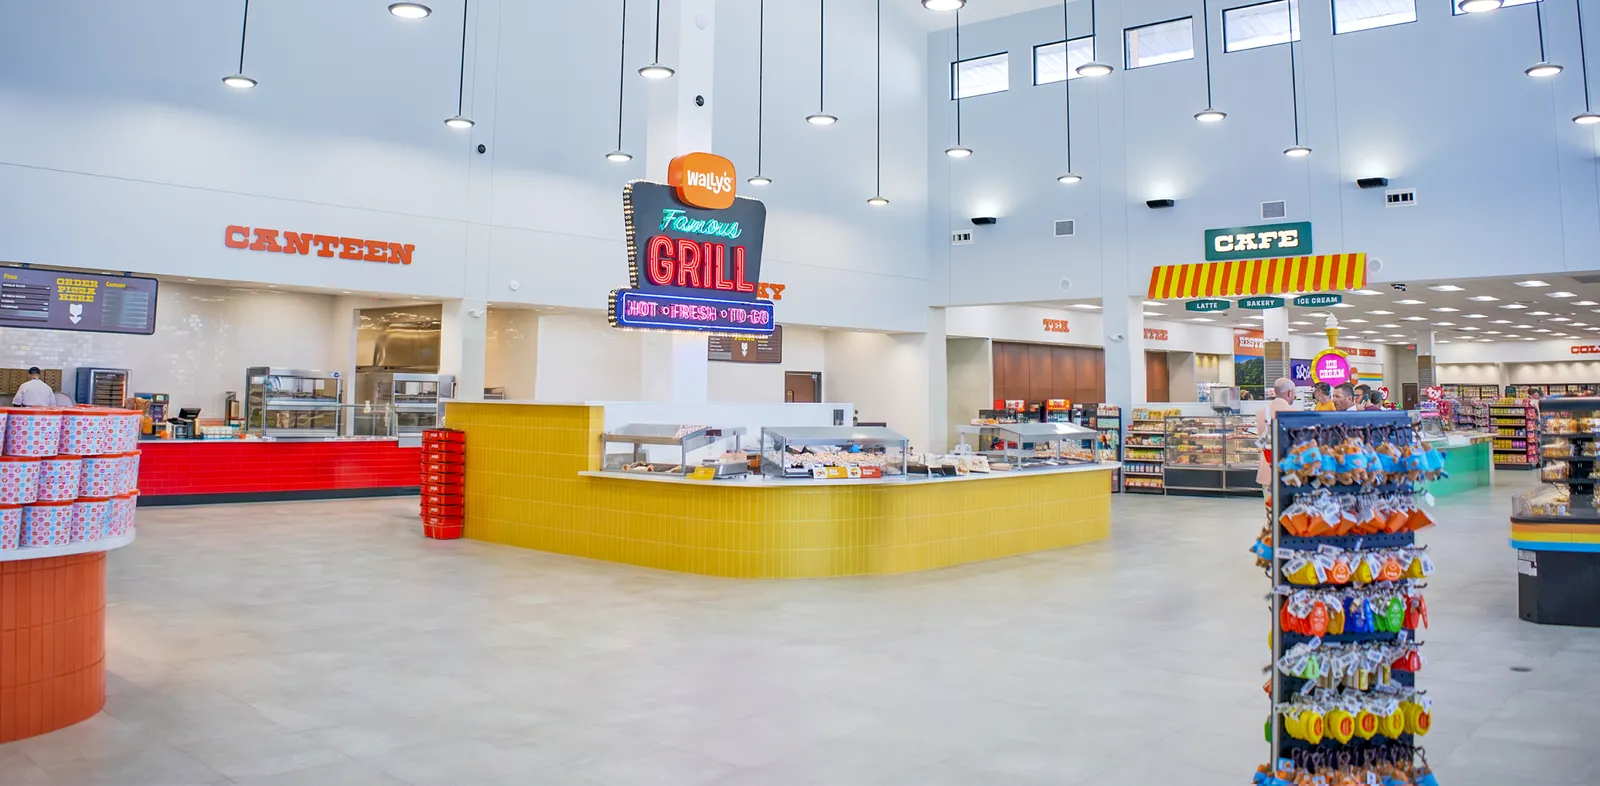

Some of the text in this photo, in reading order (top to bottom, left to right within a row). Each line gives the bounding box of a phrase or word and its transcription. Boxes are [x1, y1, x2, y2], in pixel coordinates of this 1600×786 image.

[687, 169, 732, 195] Wally's
[660, 208, 742, 239] Famous
[225, 225, 415, 265] CANTEEN
[1215, 230, 1298, 252] CAFE
[647, 234, 755, 292] GRILL
[56, 278, 99, 288] ORDER
[57, 286, 96, 295] PIZZA
[756, 281, 786, 300] KY
[59, 294, 94, 302] HERE
[1246, 299, 1275, 307] BAKERY
[1311, 296, 1338, 304] CREAM
[627, 300, 658, 317] HOT
[670, 303, 717, 321] FRESH
[1196, 301, 1218, 309] LATTE
[1043, 319, 1069, 332] TEA
[1325, 360, 1338, 369] ICE
[1319, 368, 1345, 379] CREAM
[1426, 386, 1442, 398] ty
